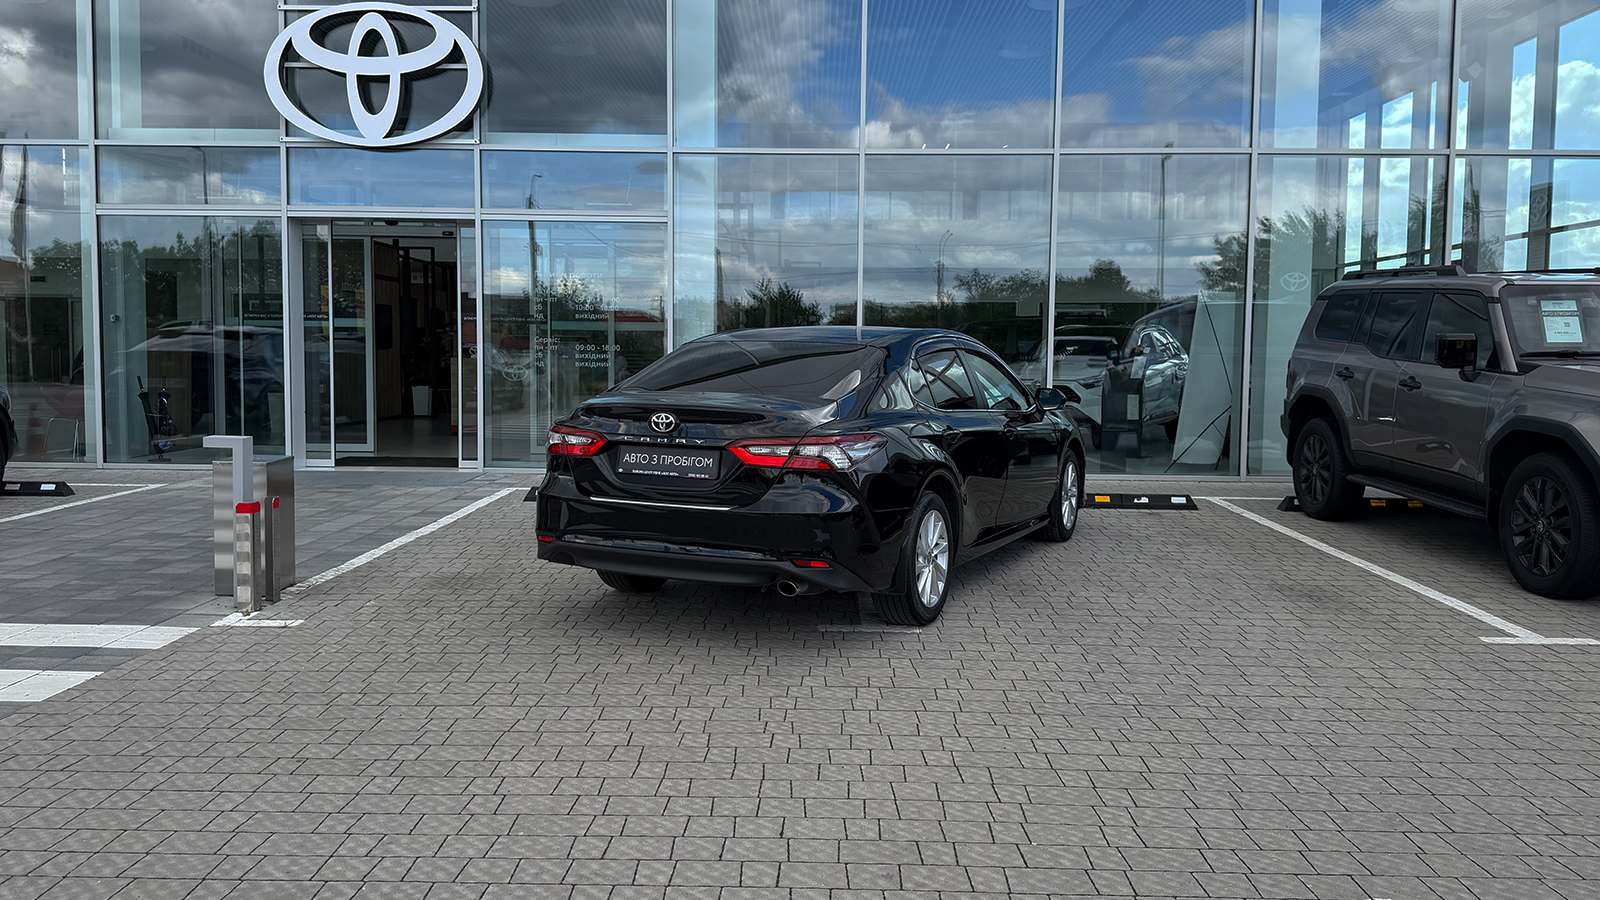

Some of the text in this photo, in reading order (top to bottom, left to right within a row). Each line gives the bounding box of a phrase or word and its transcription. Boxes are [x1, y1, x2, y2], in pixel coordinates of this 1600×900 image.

[575, 312, 610, 320] вихідний
[575, 351, 611, 360] вихідний
[575, 359, 611, 368] вихідний
[624, 435, 706, 445] CAMRY
[623, 453, 649, 464] АВТО
[660, 455, 713, 467] ПРОБІГОМ
